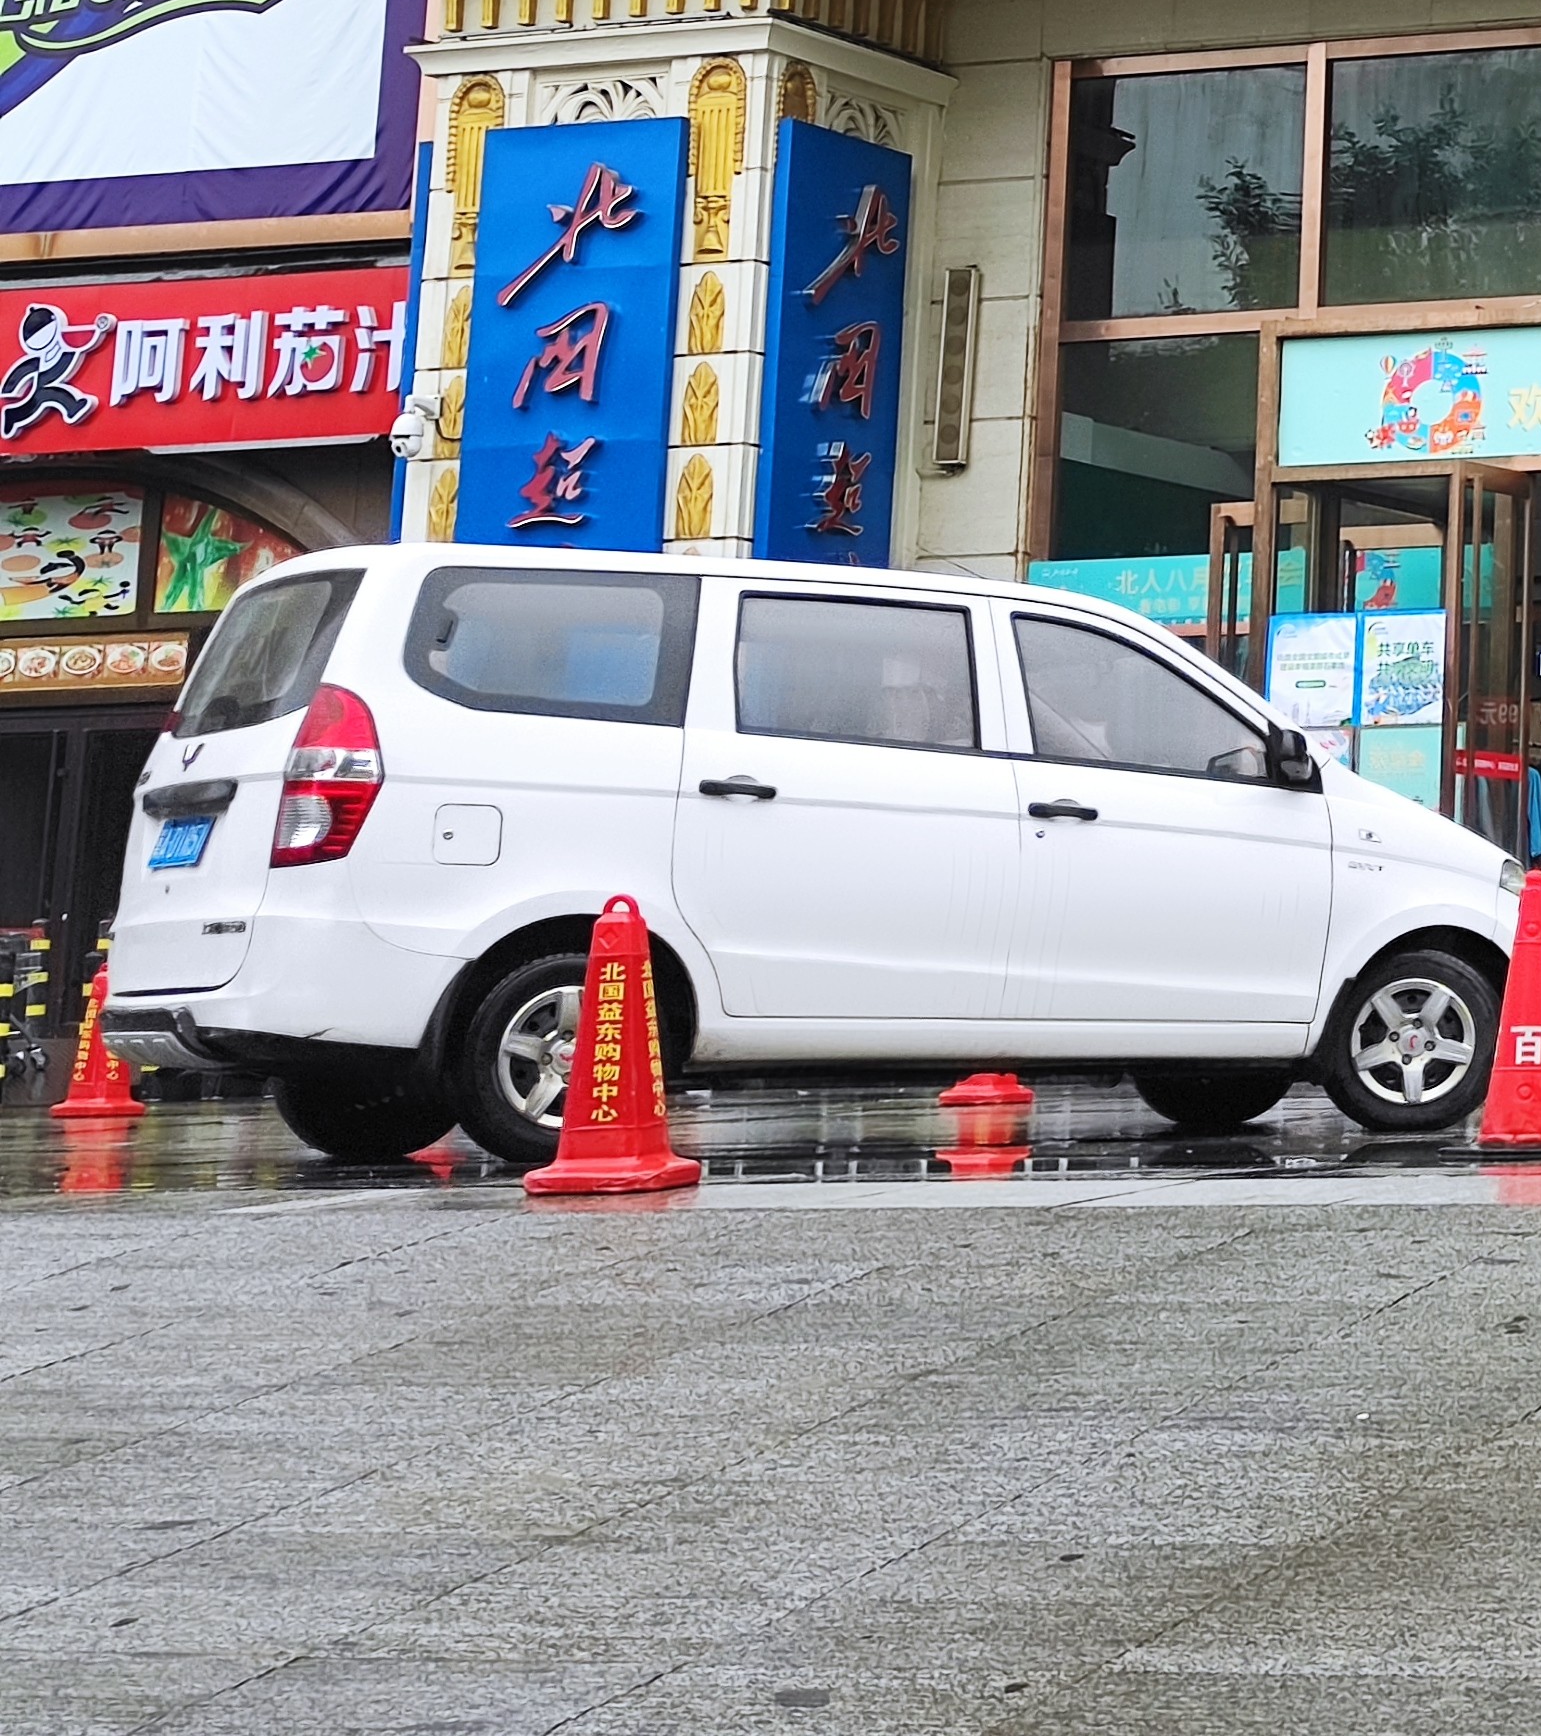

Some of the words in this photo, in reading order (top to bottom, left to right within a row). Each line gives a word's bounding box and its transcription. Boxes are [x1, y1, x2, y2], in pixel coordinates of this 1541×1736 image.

[497, 161, 637, 548] 北国超
[800, 184, 901, 566] 北国超
[1376, 640, 1435, 659] 共享单车
[590, 961, 627, 1124] 北国益东购物中心
